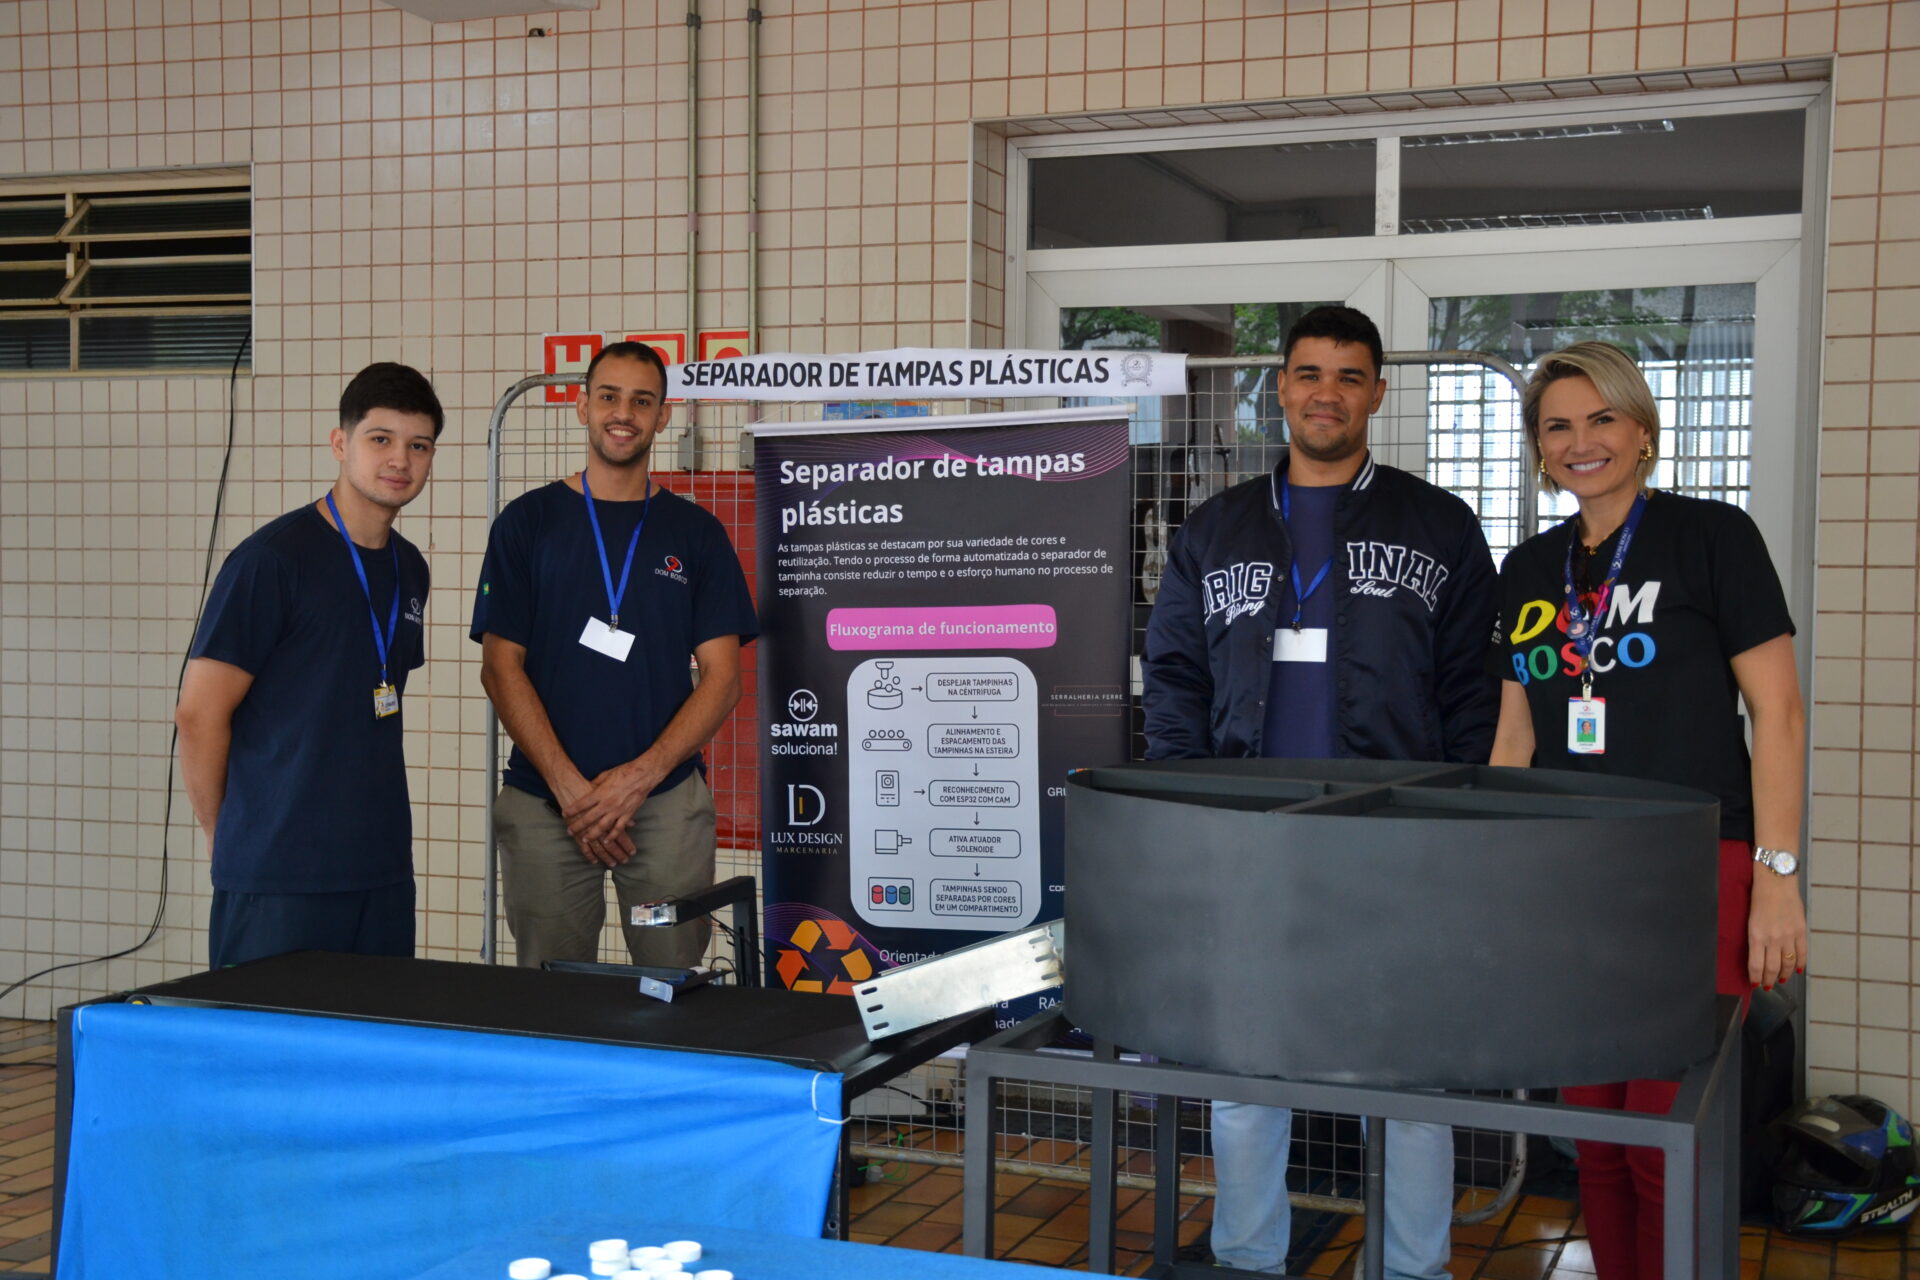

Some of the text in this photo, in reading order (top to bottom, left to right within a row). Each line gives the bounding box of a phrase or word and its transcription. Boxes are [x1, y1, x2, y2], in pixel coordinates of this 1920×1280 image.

[682, 354, 1109, 387] SEPARADOR DE TAMPAS PLÁSTICAS
[780, 452, 1086, 490] Separador de tampas
[782, 500, 903, 533] plásticas
[778, 543, 789, 553] As
[791, 544, 824, 554] tampas
[826, 541, 866, 554] plásticas
[868, 542, 878, 550] se
[881, 540, 926, 550] destacam
[928, 540, 944, 550] por
[947, 539, 963, 548] sua
[966, 536, 1013, 547] variedade
[1016, 536, 1029, 545] de
[1031, 536, 1057, 545] cores
[778, 556, 832, 568] reutilização.
[833, 555, 863, 565] Tendo
[874, 555, 915, 566] processo
[917, 553, 930, 563] de
[932, 552, 961, 563] forma
[963, 551, 1029, 562] automatizada
[1032, 552, 1038, 560] o
[1041, 549, 1091, 561] separador
[1094, 548, 1107, 558] de
[655, 568, 668, 577] DOM
[779, 572, 821, 583] tampinha
[824, 570, 860, 580] consiste
[863, 570, 895, 579] reduzir
[907, 569, 937, 580] tempo
[948, 569, 954, 577] o
[957, 567, 992, 579] esforço
[995, 567, 1035, 576] humano
[1038, 567, 1050, 575] no
[1053, 565, 1097, 577] processo
[1101, 564, 1113, 573] de
[1347, 541, 1448, 612] INAL
[779, 586, 827, 597] separação.
[1350, 579, 1397, 599] Soul
[830, 621, 1054, 639] Fluxograma de funcionamento
[1512, 632, 1656, 686] BOSCO
[771, 723, 838, 737] sawam
[771, 741, 837, 755] soluciona!
[943, 786, 1004, 794] RECONHECIMENTO
[771, 832, 842, 844] LUX DESIGN
[956, 845, 994, 853] SOLENOIDE
[942, 885, 1007, 894] TAMPINHAS SENDO
[959, 905, 1018, 913] COMPARTIMENTO
[1860, 1189, 1913, 1224] STEALTH
